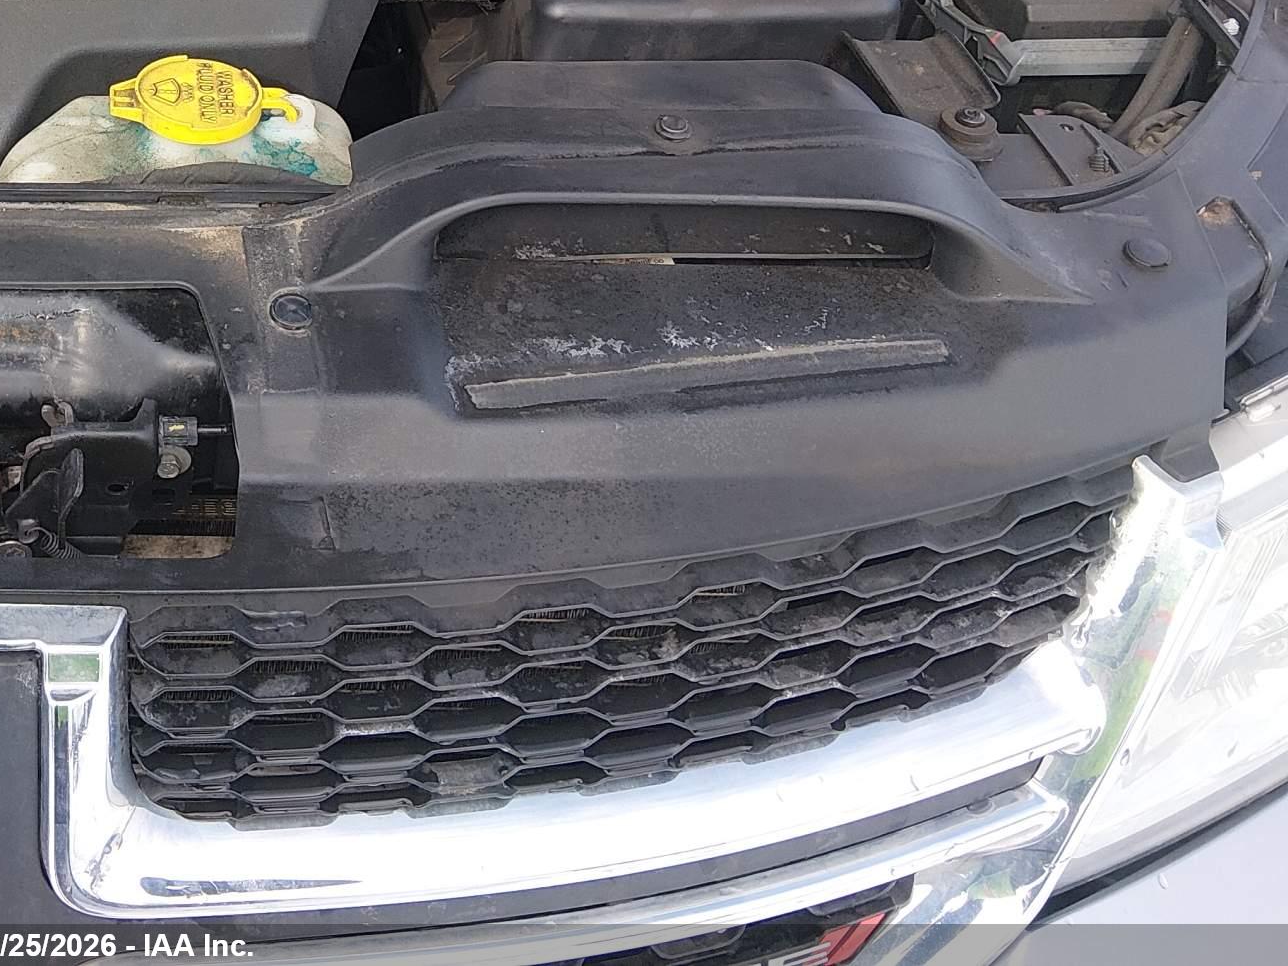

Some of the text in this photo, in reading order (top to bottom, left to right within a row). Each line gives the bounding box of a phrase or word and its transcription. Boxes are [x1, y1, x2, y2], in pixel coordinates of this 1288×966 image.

[196, 62, 217, 124] FLUID ONLY
[216, 69, 235, 117] WASHER
